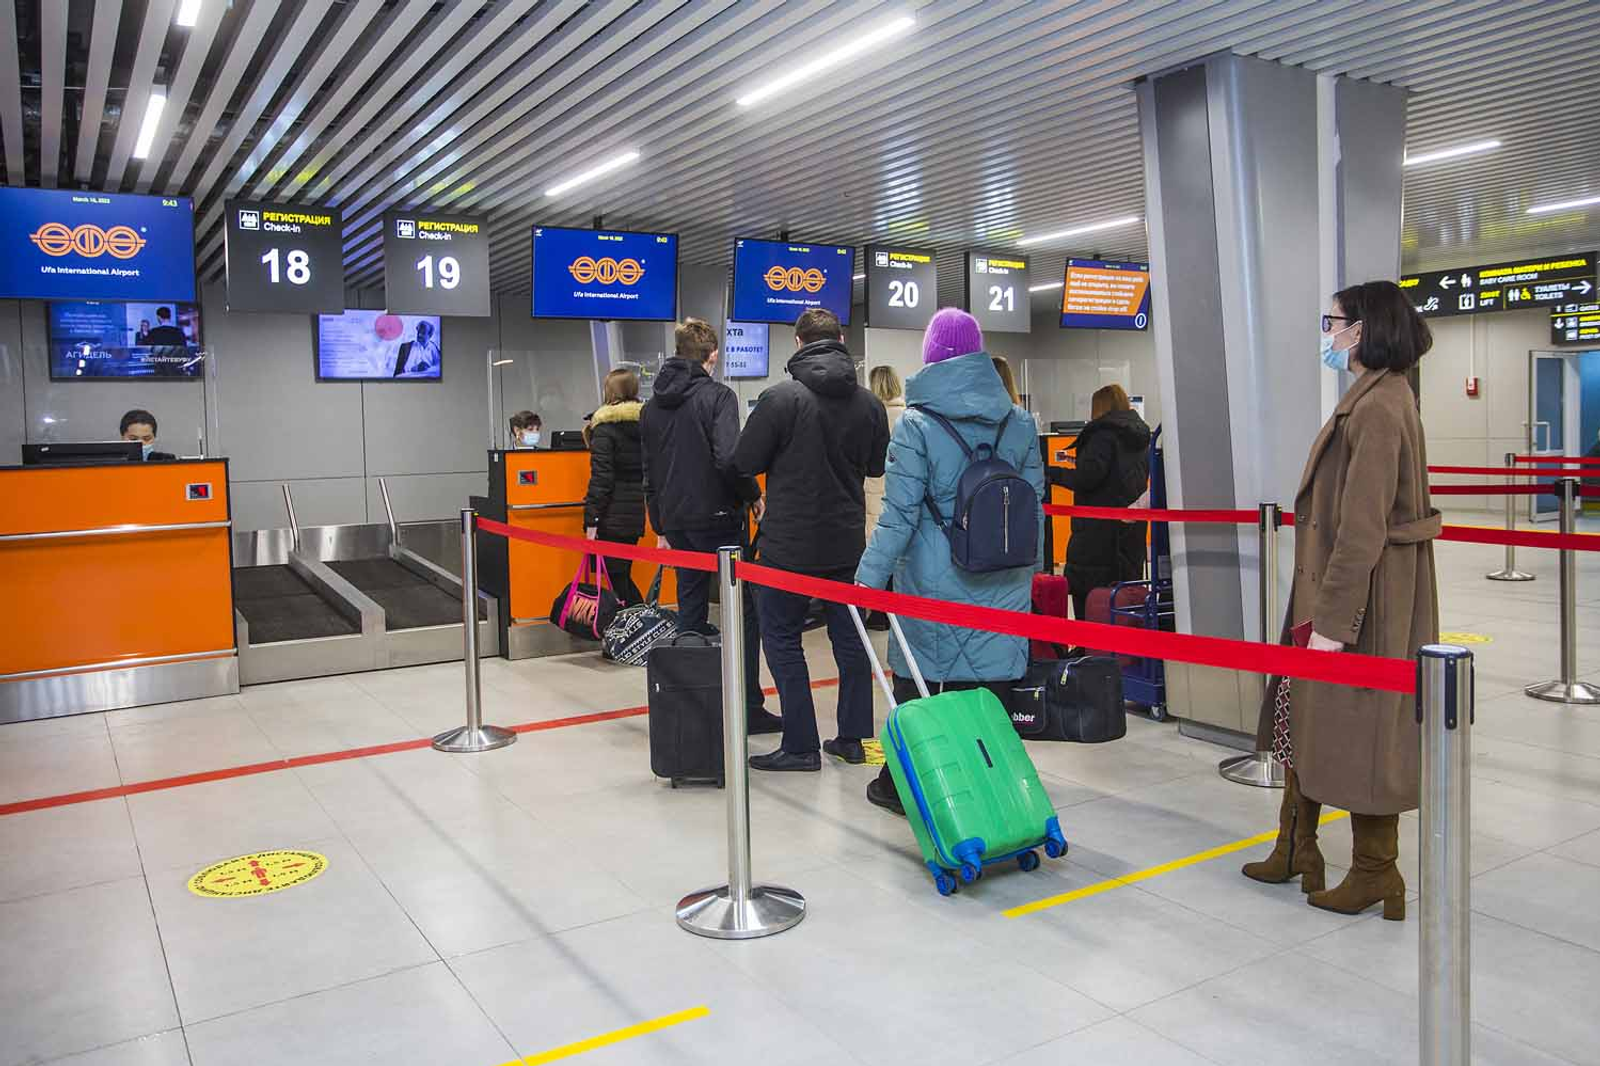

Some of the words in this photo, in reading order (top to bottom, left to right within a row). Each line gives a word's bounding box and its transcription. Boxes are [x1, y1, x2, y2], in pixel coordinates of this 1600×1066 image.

[263, 212, 331, 226] РЕГИСТРАЦИЯ
[264, 222, 301, 233] Check-in
[418, 221, 478, 233] РЕГИСТРАЦИЯ
[418, 230, 452, 240] Check-in
[41, 266, 56, 274] Ufa
[57, 266, 109, 275] International
[110, 268, 140, 278] Airport
[262, 248, 311, 285] 18
[417, 255, 460, 289] 19
[888, 280, 919, 308] 20
[989, 285, 1014, 311] 21
[66, 351, 112, 360] АГИДЕЛЬ
[631, 635, 653, 653] STYLE
[1010, 712, 1035, 722] bber
